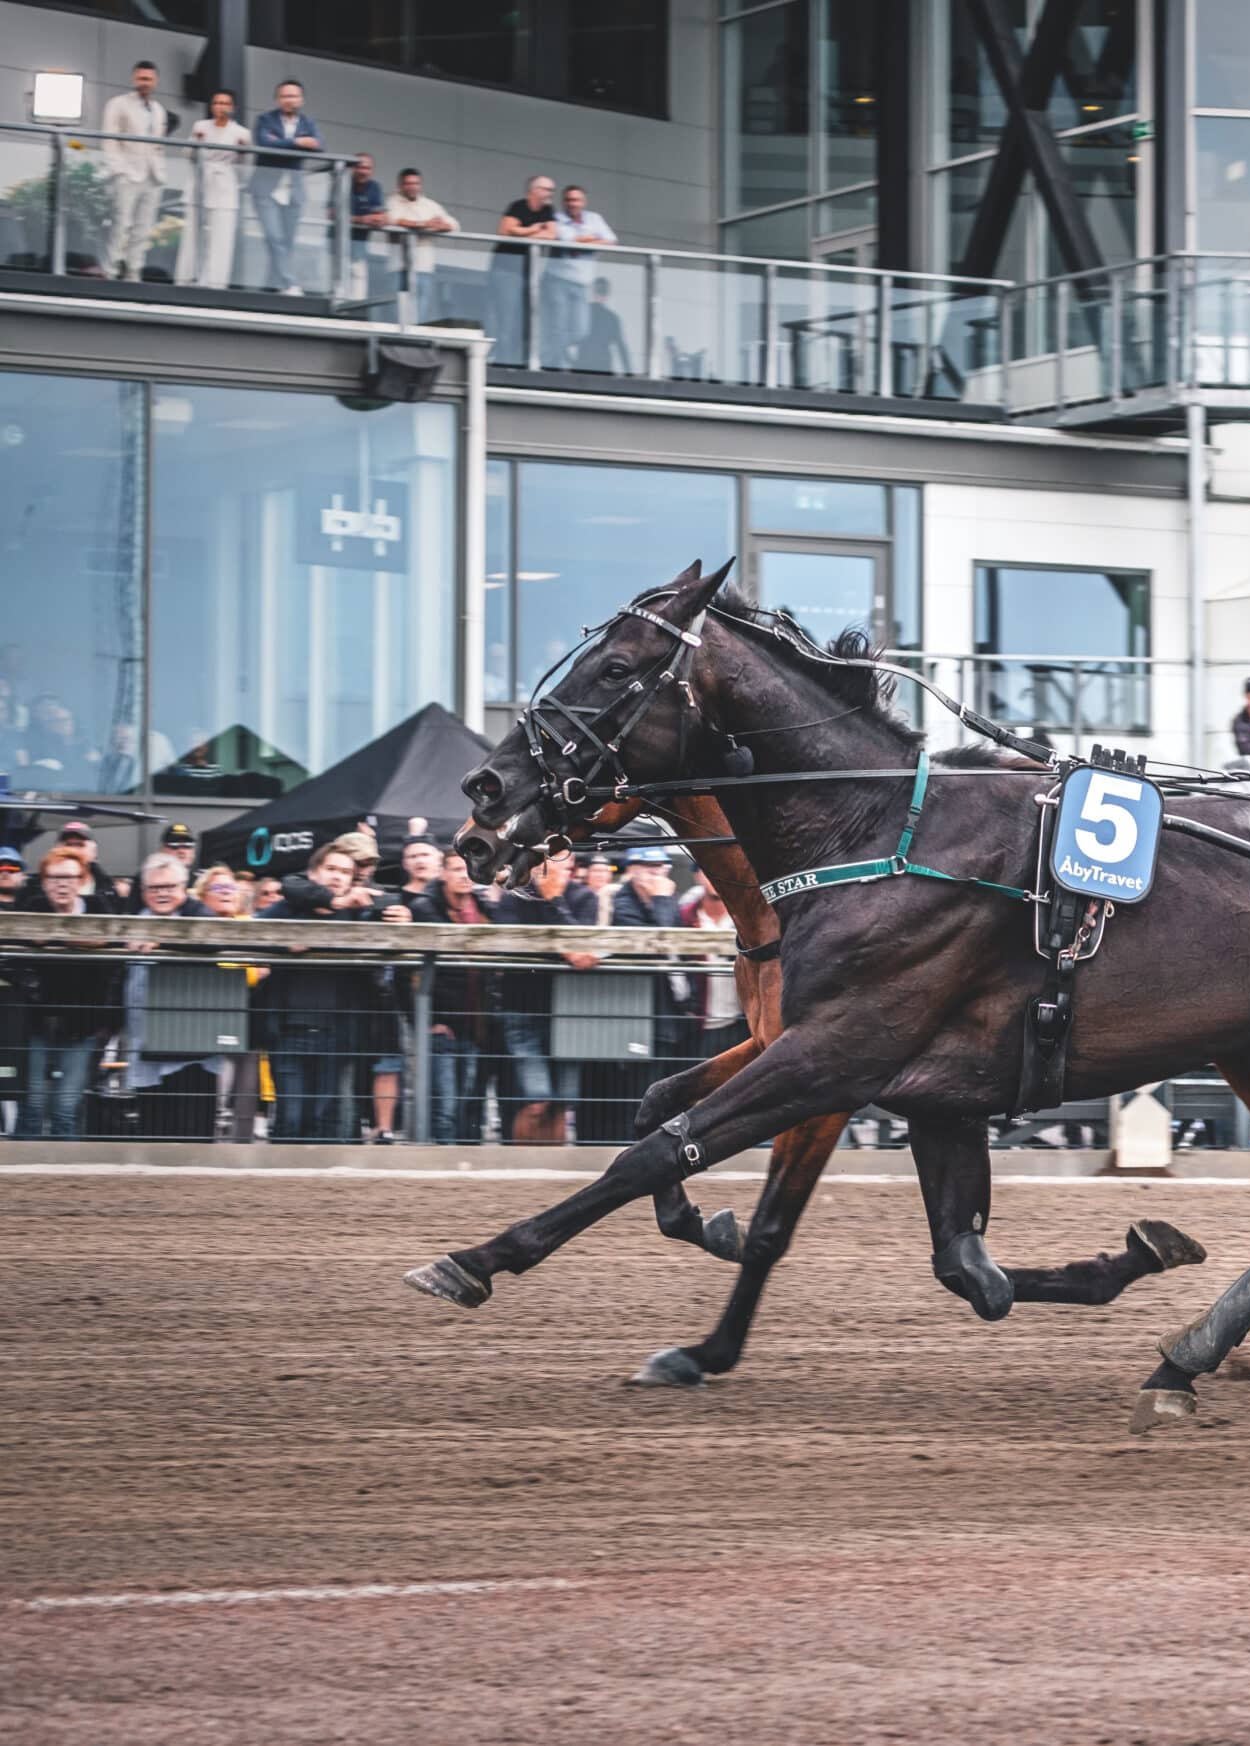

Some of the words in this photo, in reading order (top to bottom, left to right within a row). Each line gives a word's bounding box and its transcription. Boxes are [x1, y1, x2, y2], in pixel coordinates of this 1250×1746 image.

[1075, 773, 1142, 863] 5
[777, 873, 818, 894] STAR
[1059, 856, 1143, 891] ÅbyTravet
